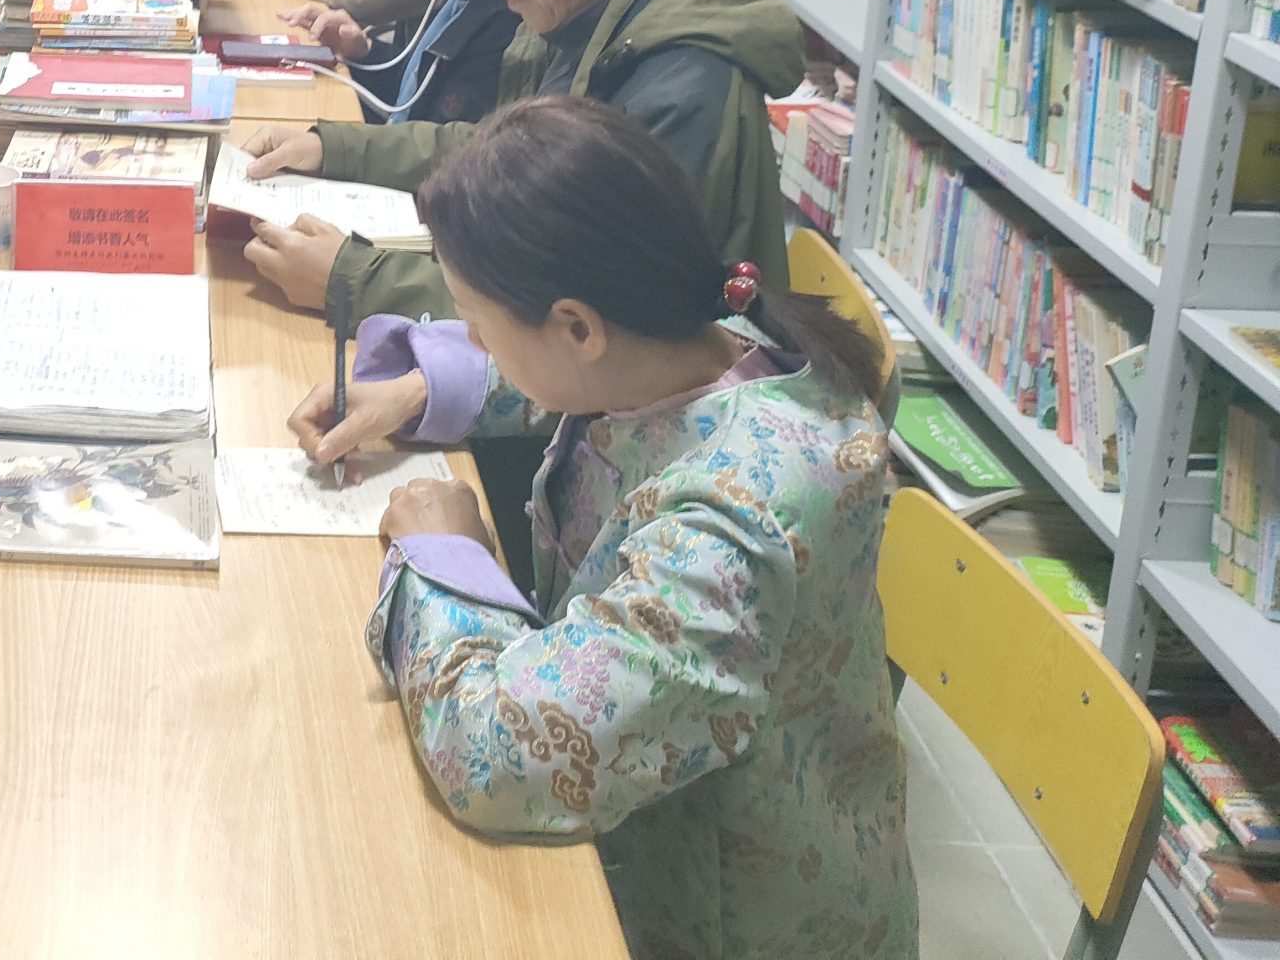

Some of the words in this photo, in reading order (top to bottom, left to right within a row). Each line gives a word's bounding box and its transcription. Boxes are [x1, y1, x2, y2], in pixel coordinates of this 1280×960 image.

[69, 207, 150, 224] 敬请在此签名
[68, 230, 150, 247] 增添书香人气
